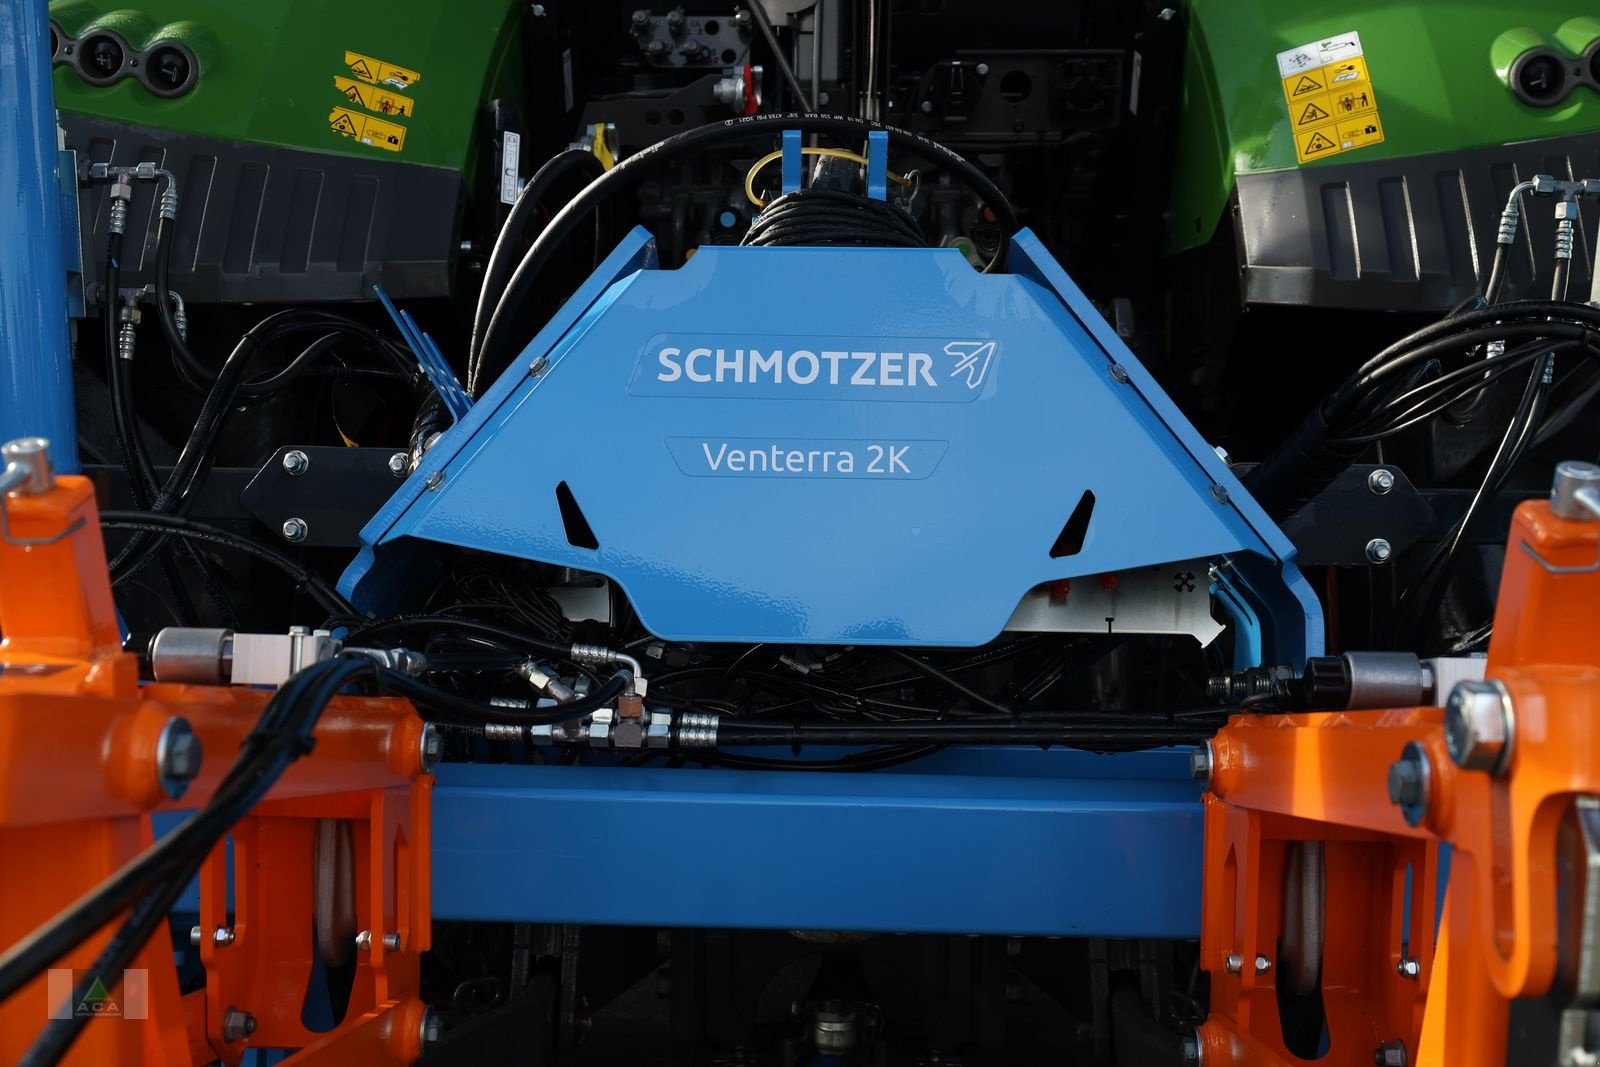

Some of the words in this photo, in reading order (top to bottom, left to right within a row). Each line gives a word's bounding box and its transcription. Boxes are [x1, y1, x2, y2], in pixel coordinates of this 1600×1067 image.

[656, 347, 938, 387] SCHMOTZER
[701, 442, 854, 473] Venterra
[866, 444, 911, 474] 2K
